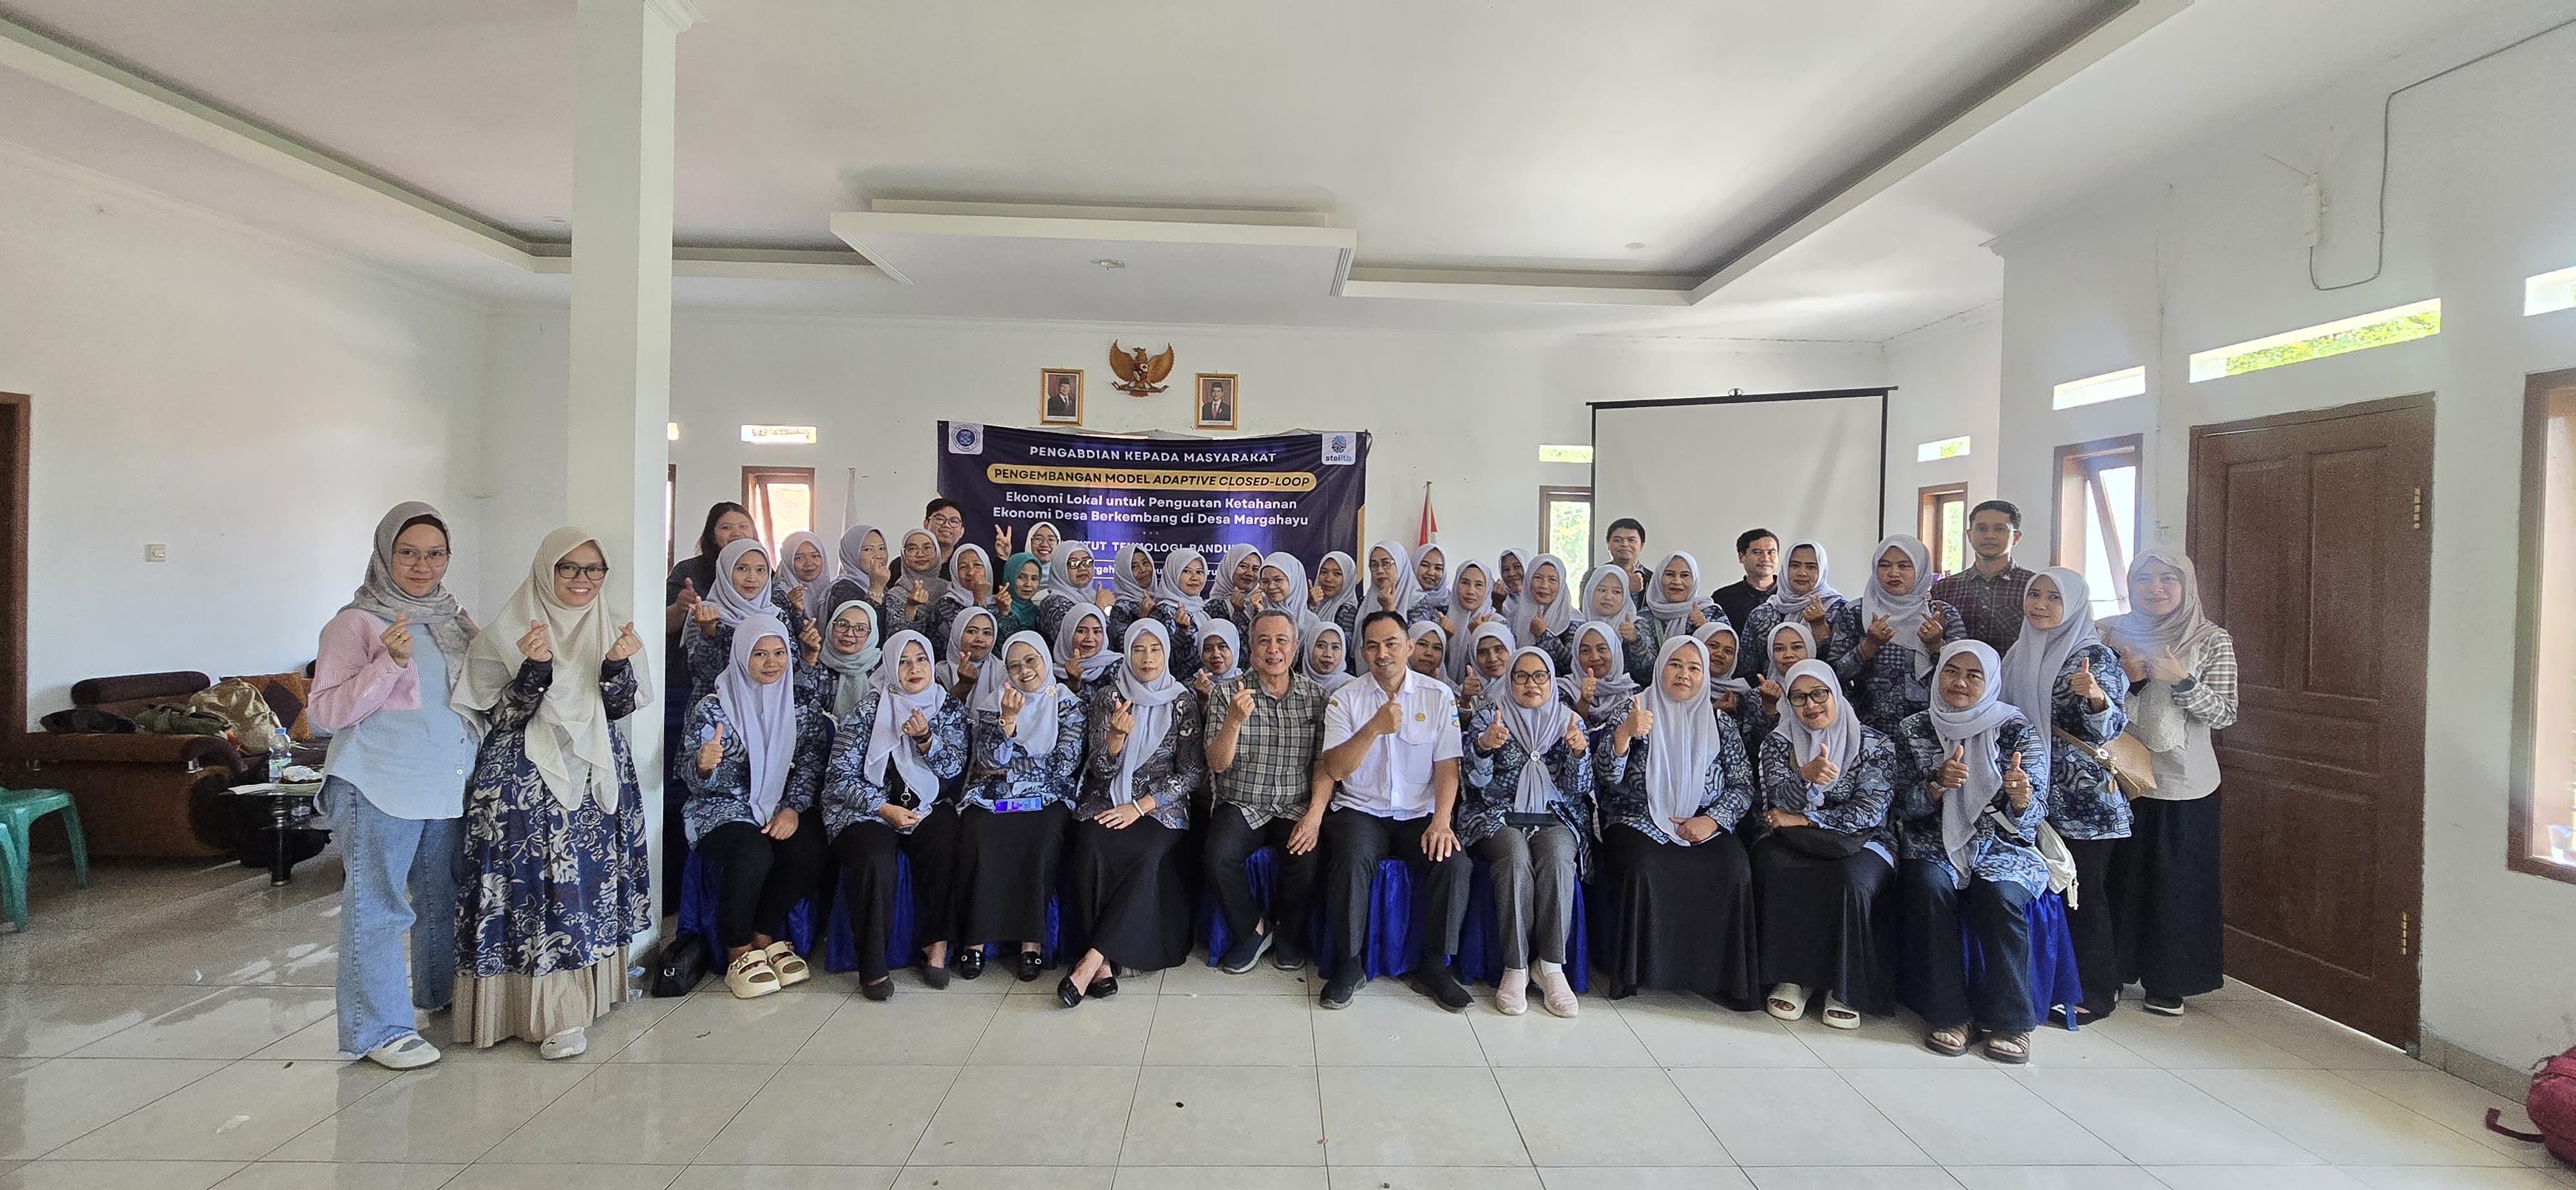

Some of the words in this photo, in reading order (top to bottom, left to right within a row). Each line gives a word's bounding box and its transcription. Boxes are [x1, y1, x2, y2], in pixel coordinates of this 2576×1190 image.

[1030, 446, 1120, 460] PENGABDIAN
[1125, 451, 1179, 462] KEPADA
[1184, 453, 1276, 462] MASYARAKAT
[994, 469, 1101, 482] PENGEMBANGAN
[1105, 474, 1151, 484] MODEL
[1153, 475, 1217, 486] ADAPTIVE
[1218, 477, 1310, 487] CLOSED-LOOP
[1006, 491, 1063, 504] Ekonomi
[1066, 494, 1103, 505] Lokal
[1106, 496, 1145, 507] untuk
[1149, 497, 1221, 510] Penguatan
[1225, 498, 1297, 509] Ketahanan
[993, 507, 1052, 519] Ekonomi
[1055, 510, 1088, 521] Desa
[1091, 510, 1177, 525] Berkembang
[1181, 513, 1193, 524] di
[1197, 514, 1230, 525] Desa
[1234, 515, 1309, 527] Margahayu
[1112, 542, 1182, 552] TEOLOGI
